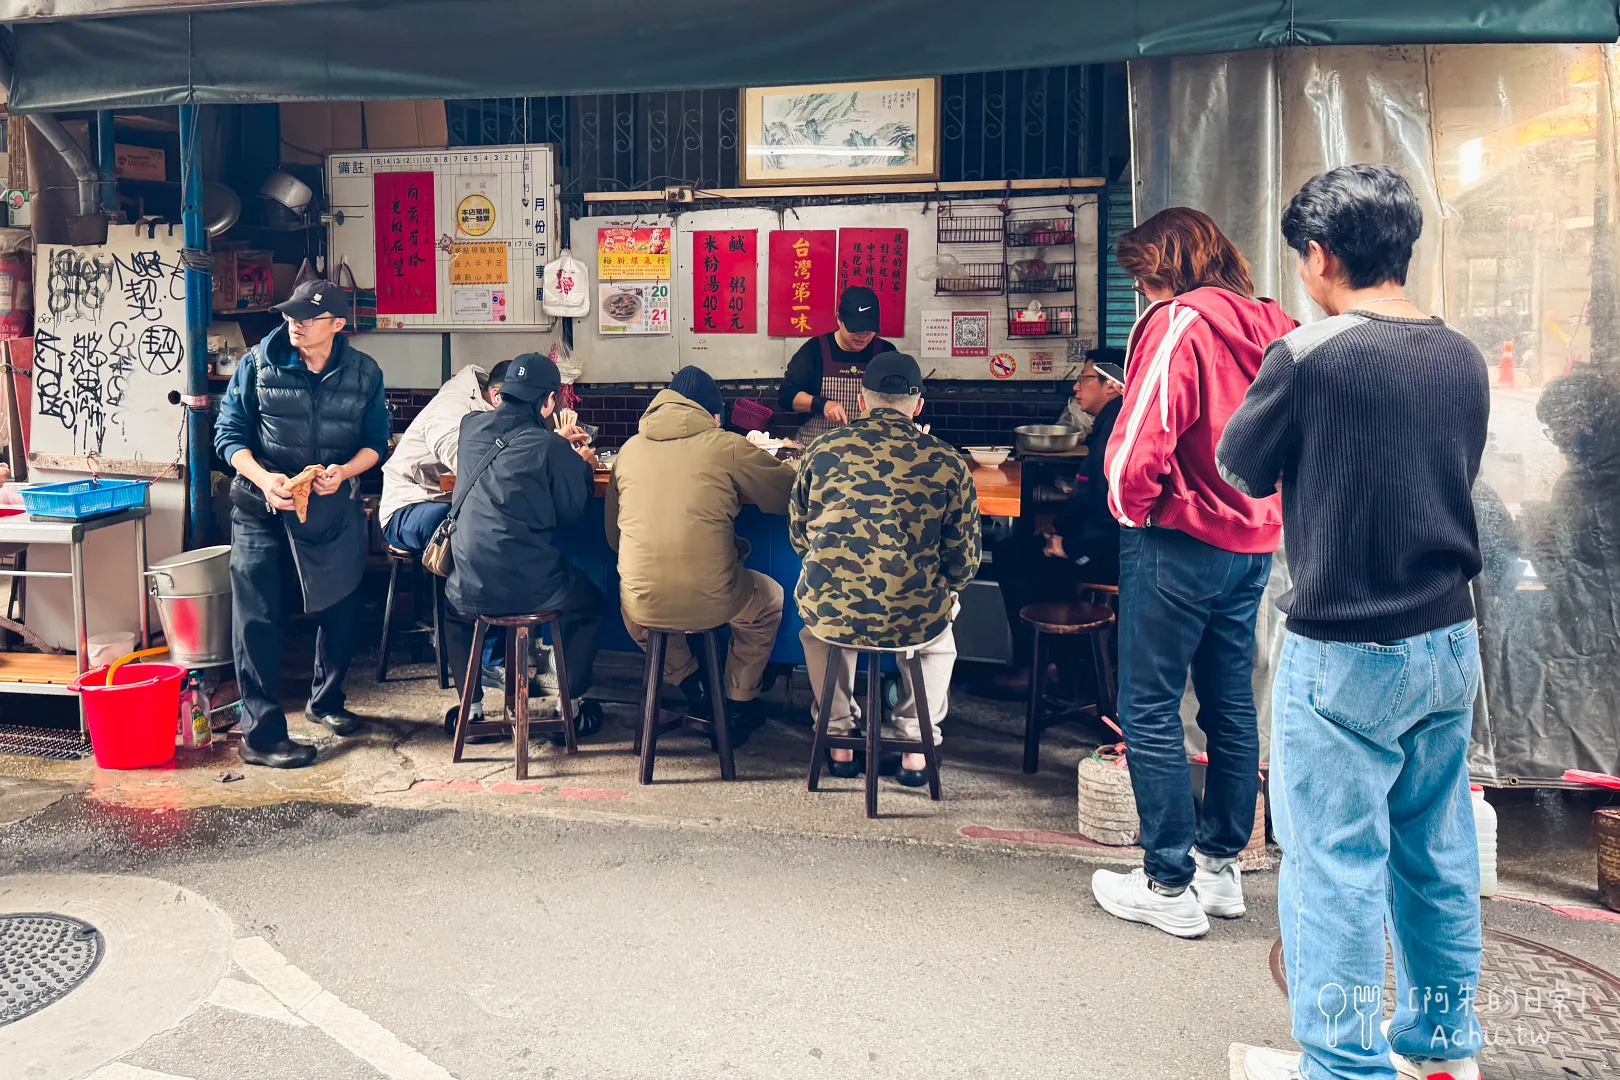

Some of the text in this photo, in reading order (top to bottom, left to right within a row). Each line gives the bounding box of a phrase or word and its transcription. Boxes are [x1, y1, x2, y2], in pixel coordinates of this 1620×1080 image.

[338, 162, 365, 174] 備註
[866, 242, 876, 290] 中午時間
[702, 234, 720, 329] 米粉湯40元
[791, 238, 812, 332] 台灣第一味
[651, 286, 668, 297] 20
[652, 309, 668, 321] 21
[518, 366, 526, 376] B
